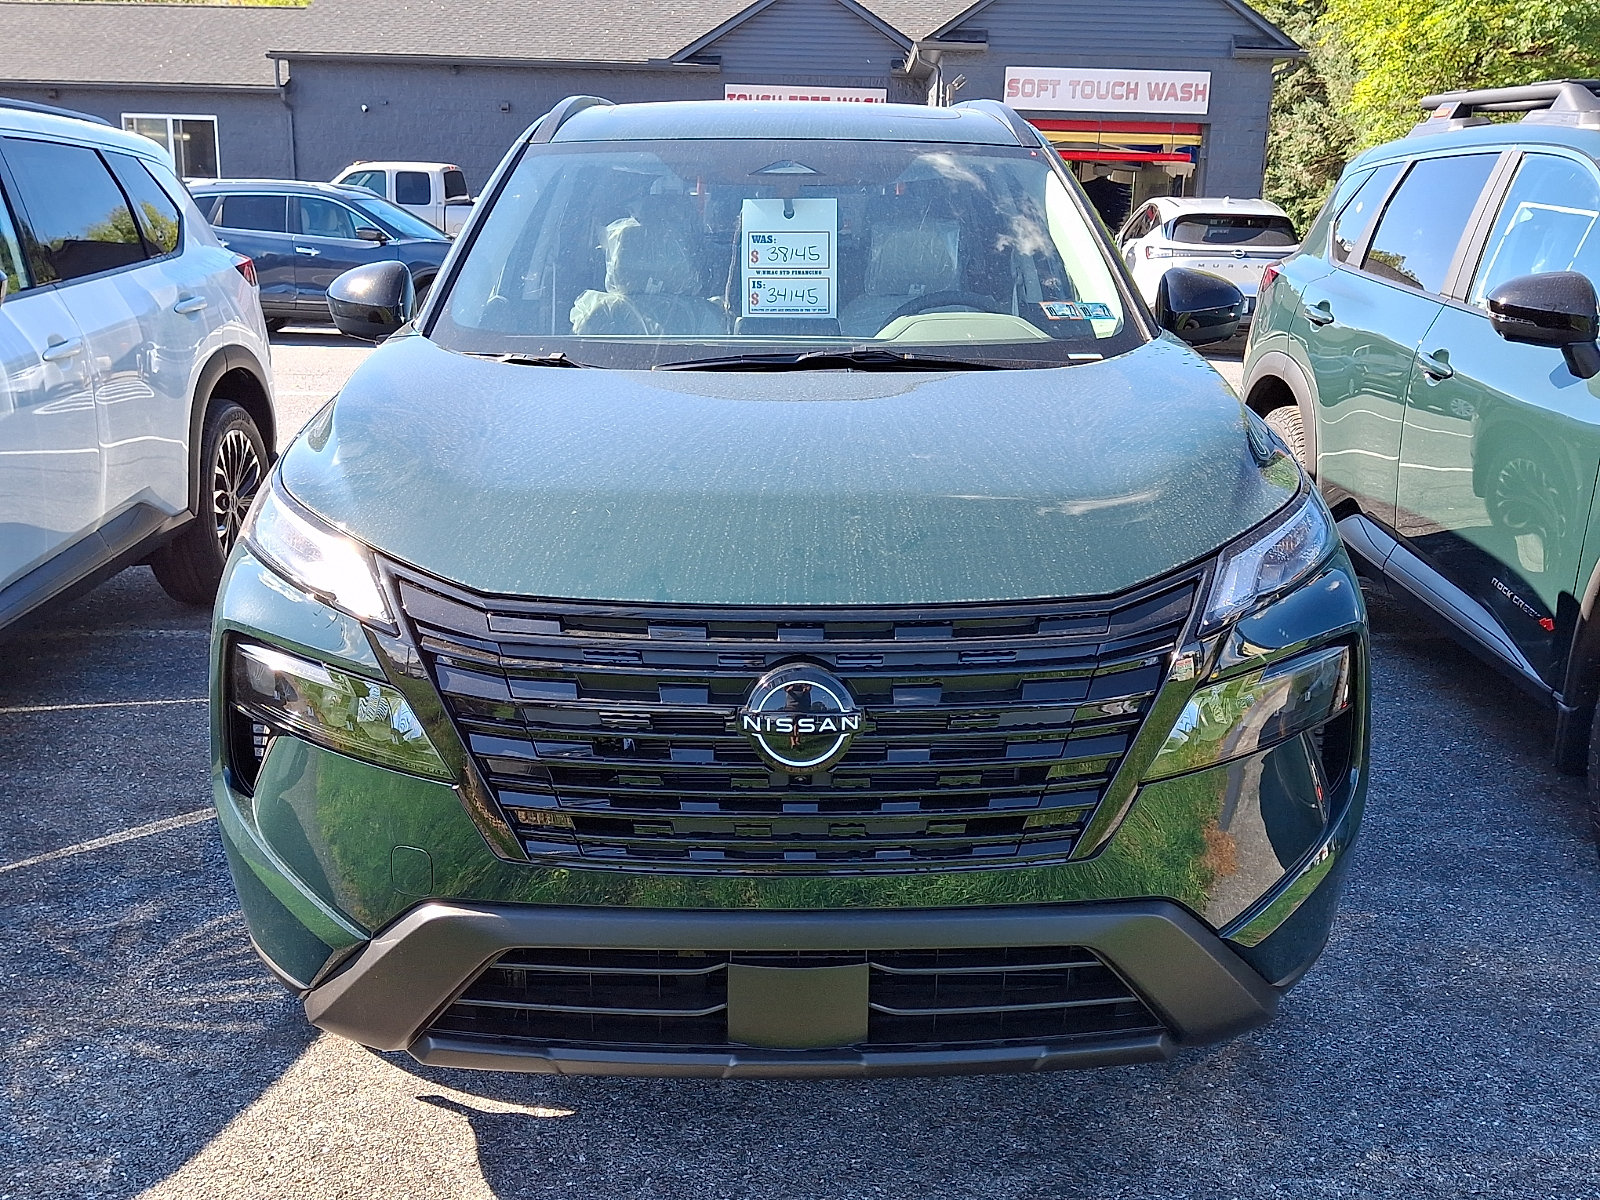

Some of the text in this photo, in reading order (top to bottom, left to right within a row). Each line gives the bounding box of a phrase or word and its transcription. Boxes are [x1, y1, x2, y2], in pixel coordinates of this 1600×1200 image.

[1007, 78, 1207, 102] SOFT TOUCH WASH
[751, 235, 777, 244] WAS:
[766, 245, 821, 263] 38145
[751, 280, 766, 289] IS:
[766, 287, 819, 305] 34145
[1491, 577, 1514, 598] ROCK
[743, 715, 859, 733] NISSAN
